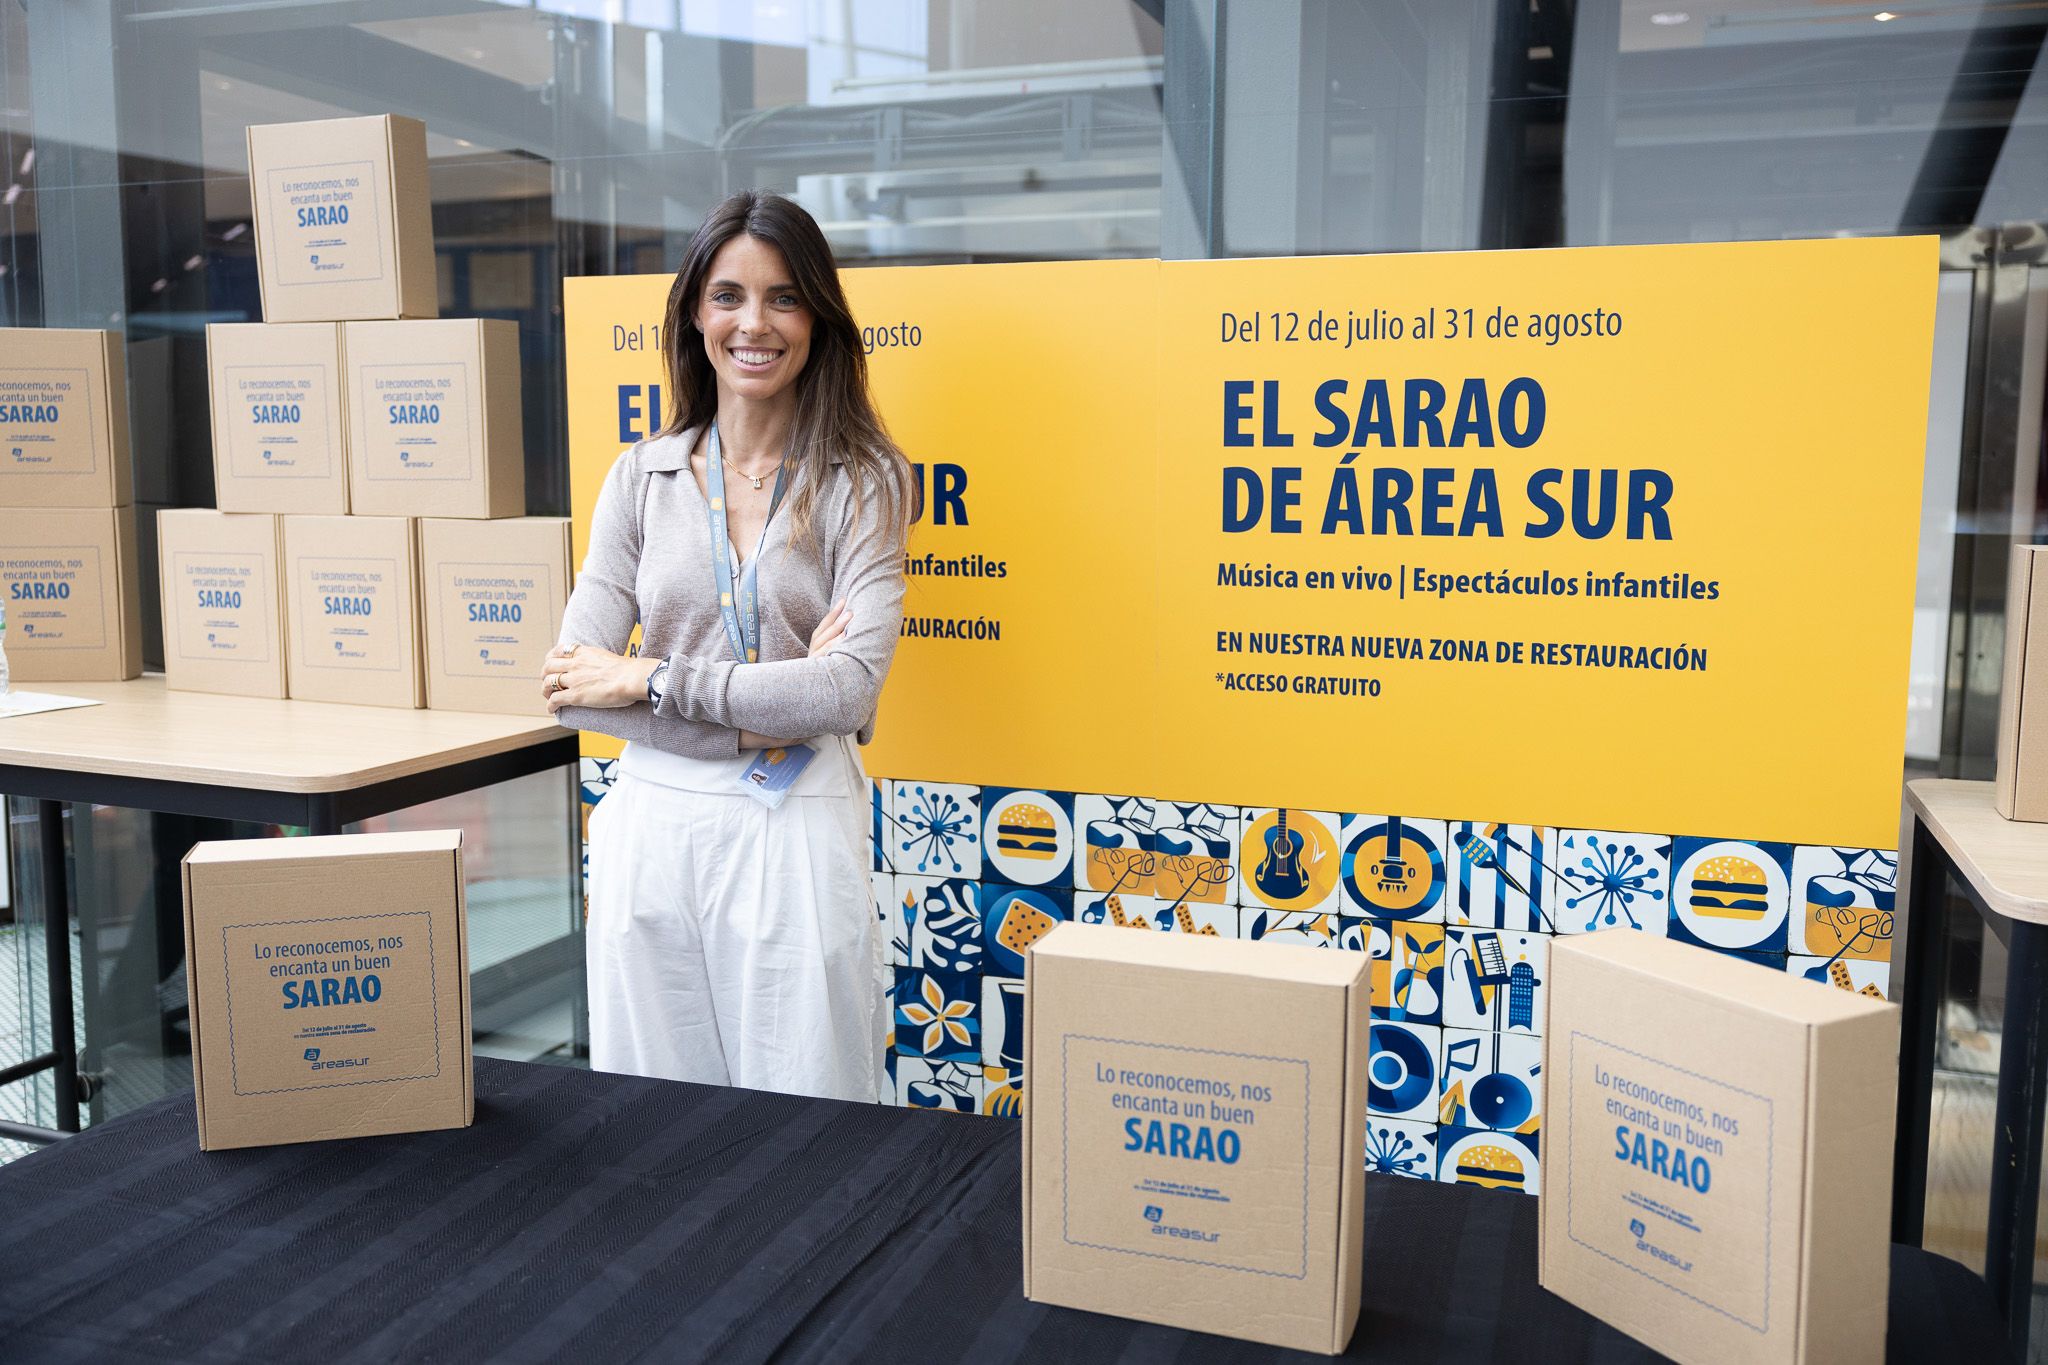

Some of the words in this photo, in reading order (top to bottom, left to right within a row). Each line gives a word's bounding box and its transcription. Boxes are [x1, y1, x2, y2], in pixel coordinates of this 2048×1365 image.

[283, 182, 291, 192] Lo
[293, 180, 344, 191] reconocemos,
[345, 178, 359, 188] nos
[291, 194, 320, 205] encanta
[322, 193, 332, 202] un
[333, 191, 353, 202] buen
[297, 205, 349, 227] SARAO
[613, 324, 643, 351] Del
[652, 325, 659, 350] 1
[863, 322, 922, 355] gosto
[1221, 311, 1261, 343] Del
[1270, 311, 1299, 342] 12
[1308, 309, 1339, 342] de
[1346, 309, 1404, 349] julio
[1413, 307, 1435, 340] al
[1445, 308, 1476, 340] 31
[1486, 306, 1519, 338] de
[1527, 306, 1623, 345] agosto
[28, 394, 39, 402] un
[41, 392, 64, 402] buen
[56, 382, 71, 391] nos
[0, 405, 59, 423] SARAO
[252, 405, 301, 423] SARAO
[389, 404, 440, 424] SARAO
[1222, 380, 1294, 447] EL
[1312, 376, 1547, 449] SARAO
[1222, 466, 1302, 534] DE
[1321, 452, 1504, 538] ÁREA
[1524, 468, 1674, 541] SUR
[3, 571, 37, 580] encanta
[53, 570, 75, 579] buen
[7, 560, 65, 569] reconocemos,
[67, 560, 83, 568] nos
[904, 553, 1007, 578] infantiles
[11, 582, 70, 600] SARAO
[520, 579, 534, 588] nos
[1217, 562, 1298, 589] Música
[1305, 569, 1335, 590] en
[1341, 566, 1393, 591] vivo
[1413, 568, 1579, 599] Espectáculos
[1586, 572, 1720, 601] infantiles
[198, 590, 241, 608] SARAO
[324, 596, 372, 616] SARAO
[462, 590, 492, 600] encanta
[494, 592, 505, 600] un
[506, 591, 527, 600] buen
[468, 603, 522, 623] SARAO
[900, 616, 1000, 641] TAURACIÓN
[1216, 631, 1243, 653] EN
[1249, 632, 1345, 658] NUESTRA
[1351, 636, 1423, 661] NUEVA
[1429, 639, 1489, 663] ZONA
[1496, 641, 1524, 664] DE
[1530, 642, 1708, 672] RESTAURACIÓN
[1293, 675, 1382, 697] GRATUITO
[255, 944, 271, 960] Lo
[275, 939, 374, 957] reconocemos,
[378, 936, 403, 949] nos
[270, 959, 327, 977] encanta
[332, 960, 350, 972] un
[354, 955, 390, 971] buen
[282, 974, 381, 1010] SARAO
[311, 1057, 370, 1070] areasur
[1097, 1062, 1115, 1083] Lo
[1120, 1069, 1236, 1100] reconocemos,
[1241, 1084, 1272, 1102] nos
[1112, 1092, 1178, 1116] encanta
[1184, 1102, 1205, 1118] un
[1211, 1100, 1254, 1124] buen
[1595, 1064, 1609, 1087] Lo
[1613, 1074, 1708, 1127] reconocemos,
[1713, 1112, 1739, 1136] nos
[1606, 1097, 1659, 1132] encanta
[1664, 1122, 1681, 1140] un
[1686, 1124, 1723, 1157] buen
[1124, 1117, 1241, 1164] SARAO
[1615, 1125, 1711, 1194] SARAO
[1152, 1224, 1220, 1242] areasur
